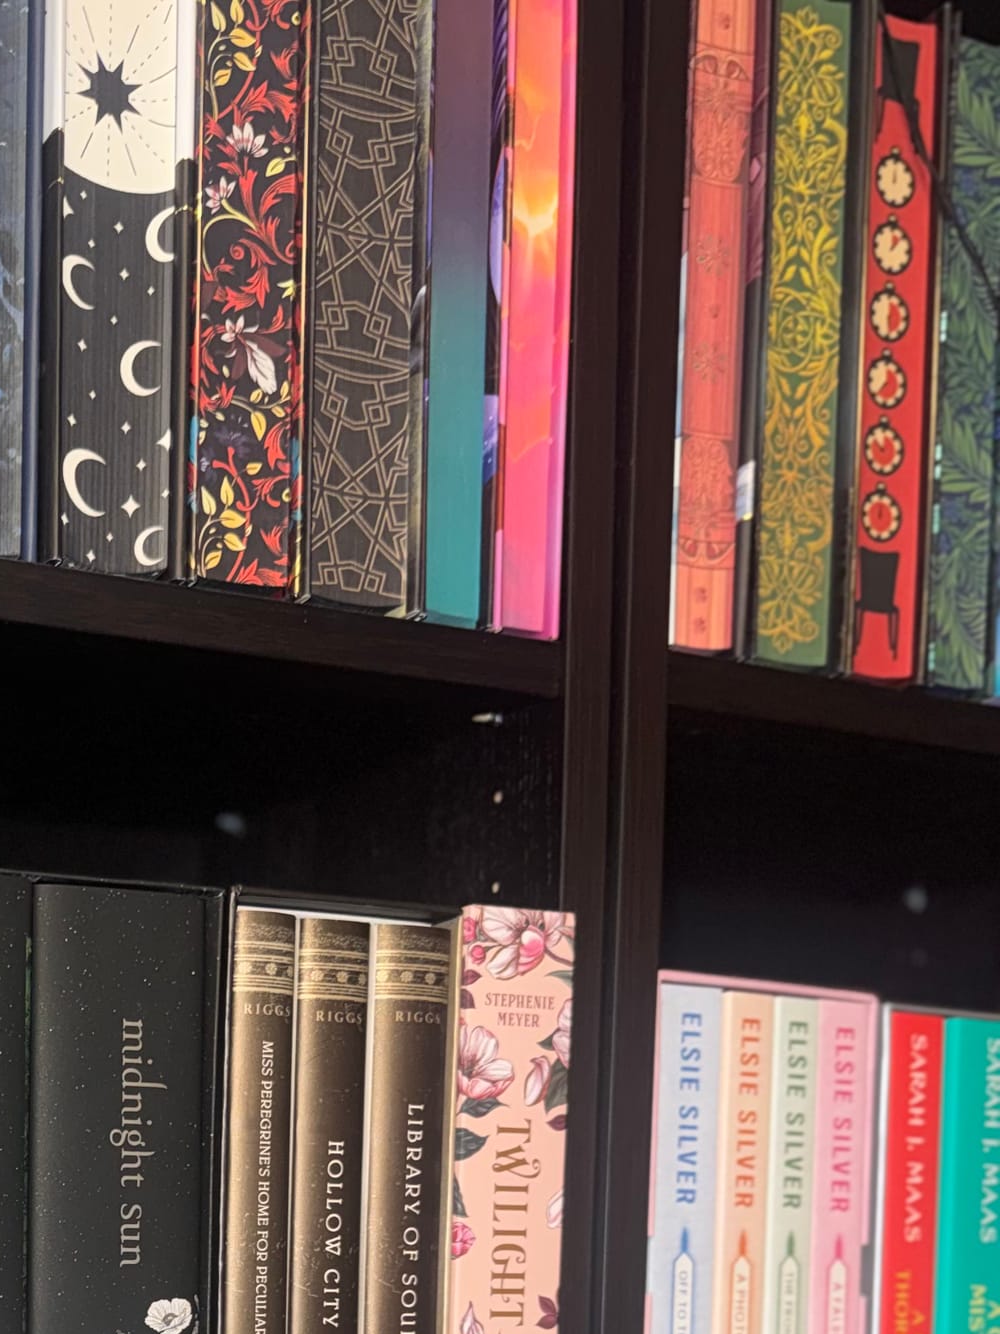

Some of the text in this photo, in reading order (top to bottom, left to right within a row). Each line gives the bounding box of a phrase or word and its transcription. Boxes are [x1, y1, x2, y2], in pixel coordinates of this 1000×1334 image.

[243, 1003, 291, 1017] RIGGS
[315, 1010, 363, 1025] RIGGS
[394, 1012, 441, 1025] RIGGS
[484, 993, 555, 1010] STEPHENIE
[497, 1012, 540, 1028] MEYER
[259, 1041, 275, 1076] MISS
[109, 1018, 167, 1267] midnight sun
[255, 1080, 274, 1176] PEREGRINE'S
[676, 1012, 702, 1205] ELSIE SILVER
[735, 1017, 761, 1208] ELSIE SILVER
[782, 1021, 808, 1209] ELSIE SILVER
[830, 1027, 855, 1213] ELSIE SILVER
[903, 1034, 929, 1242] SARAH J. MAAS
[255, 1181, 271, 1225] HOME
[403, 1103, 424, 1213] LIBRARY
[255, 1230, 270, 1259] FOR
[321, 1141, 345, 1328] HOLLOW CITY
[401, 1227, 420, 1262] OF
[488, 1118, 541, 1325] TWILIGHT
